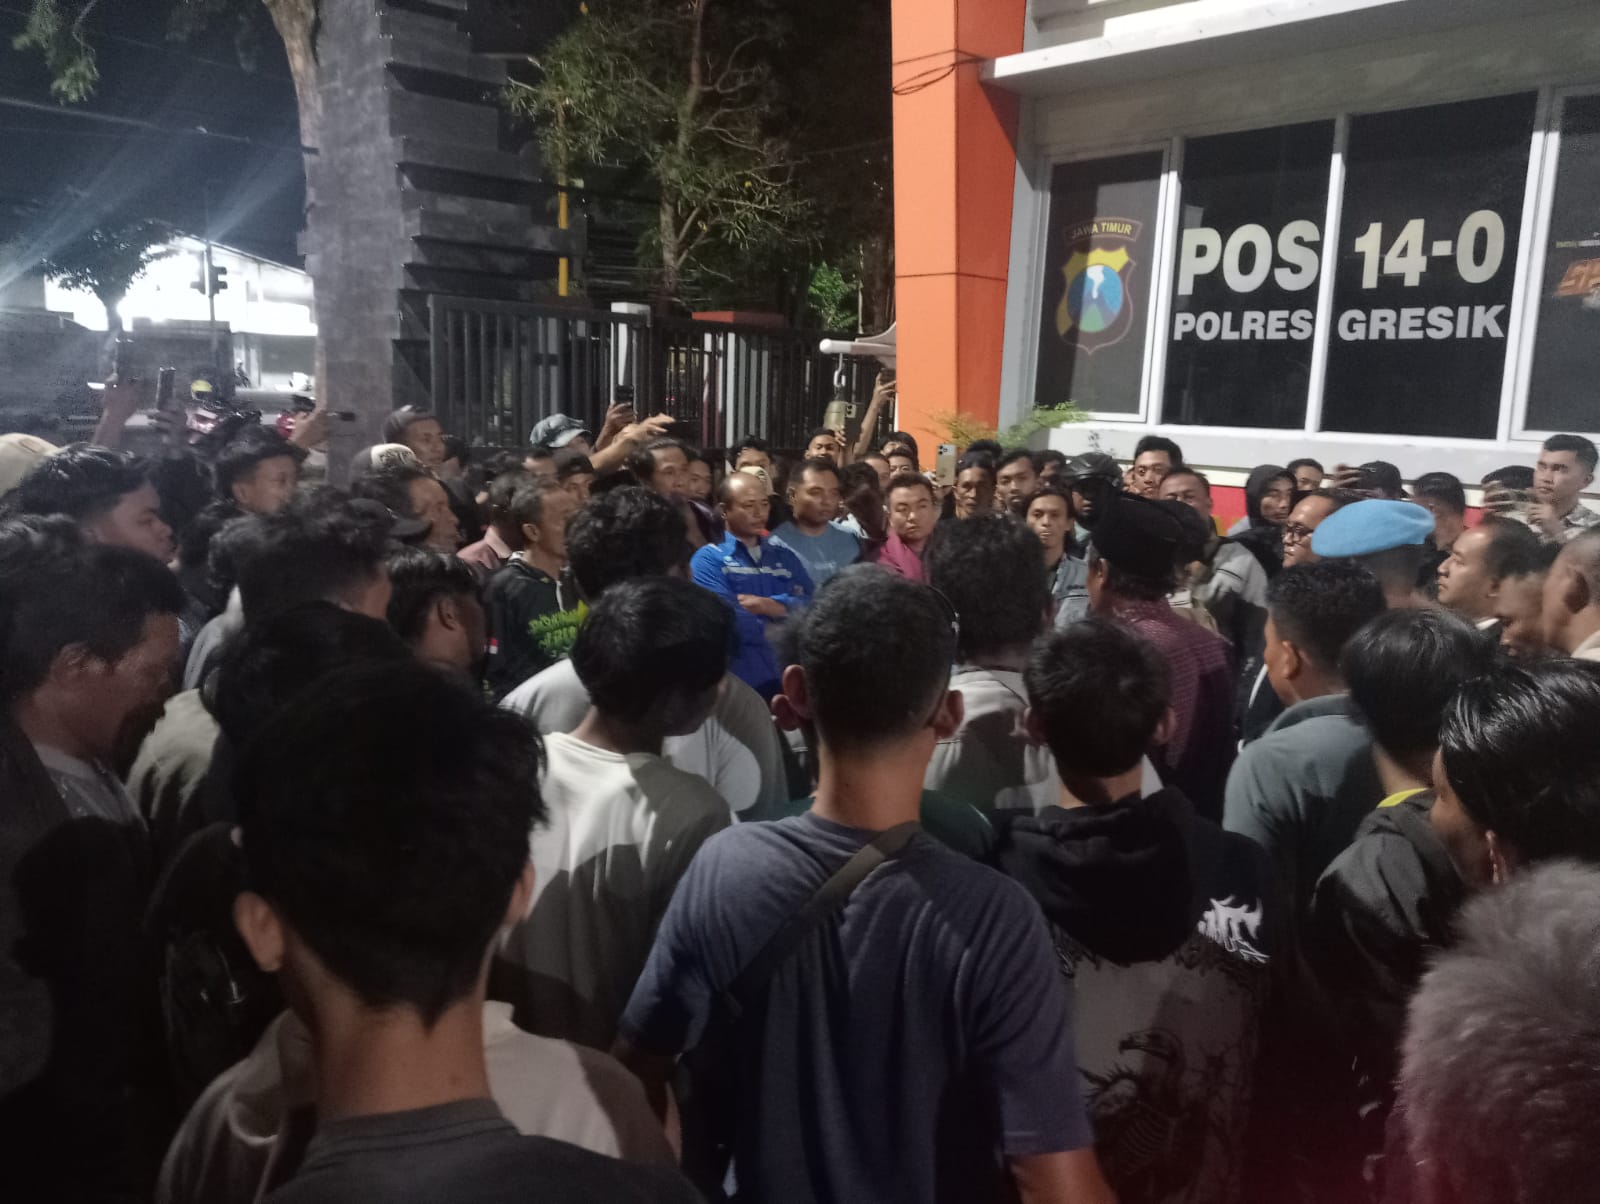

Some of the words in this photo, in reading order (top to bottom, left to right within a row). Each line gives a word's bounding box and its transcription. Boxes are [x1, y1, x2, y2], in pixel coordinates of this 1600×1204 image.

[1072, 223, 1099, 239] JAWA
[1101, 222, 1132, 235] TIMUR
[1178, 219, 1321, 296] POS
[1355, 209, 1505, 289] 14-0
[1173, 308, 1314, 341] POLRES
[1337, 304, 1506, 341] GRESIK
